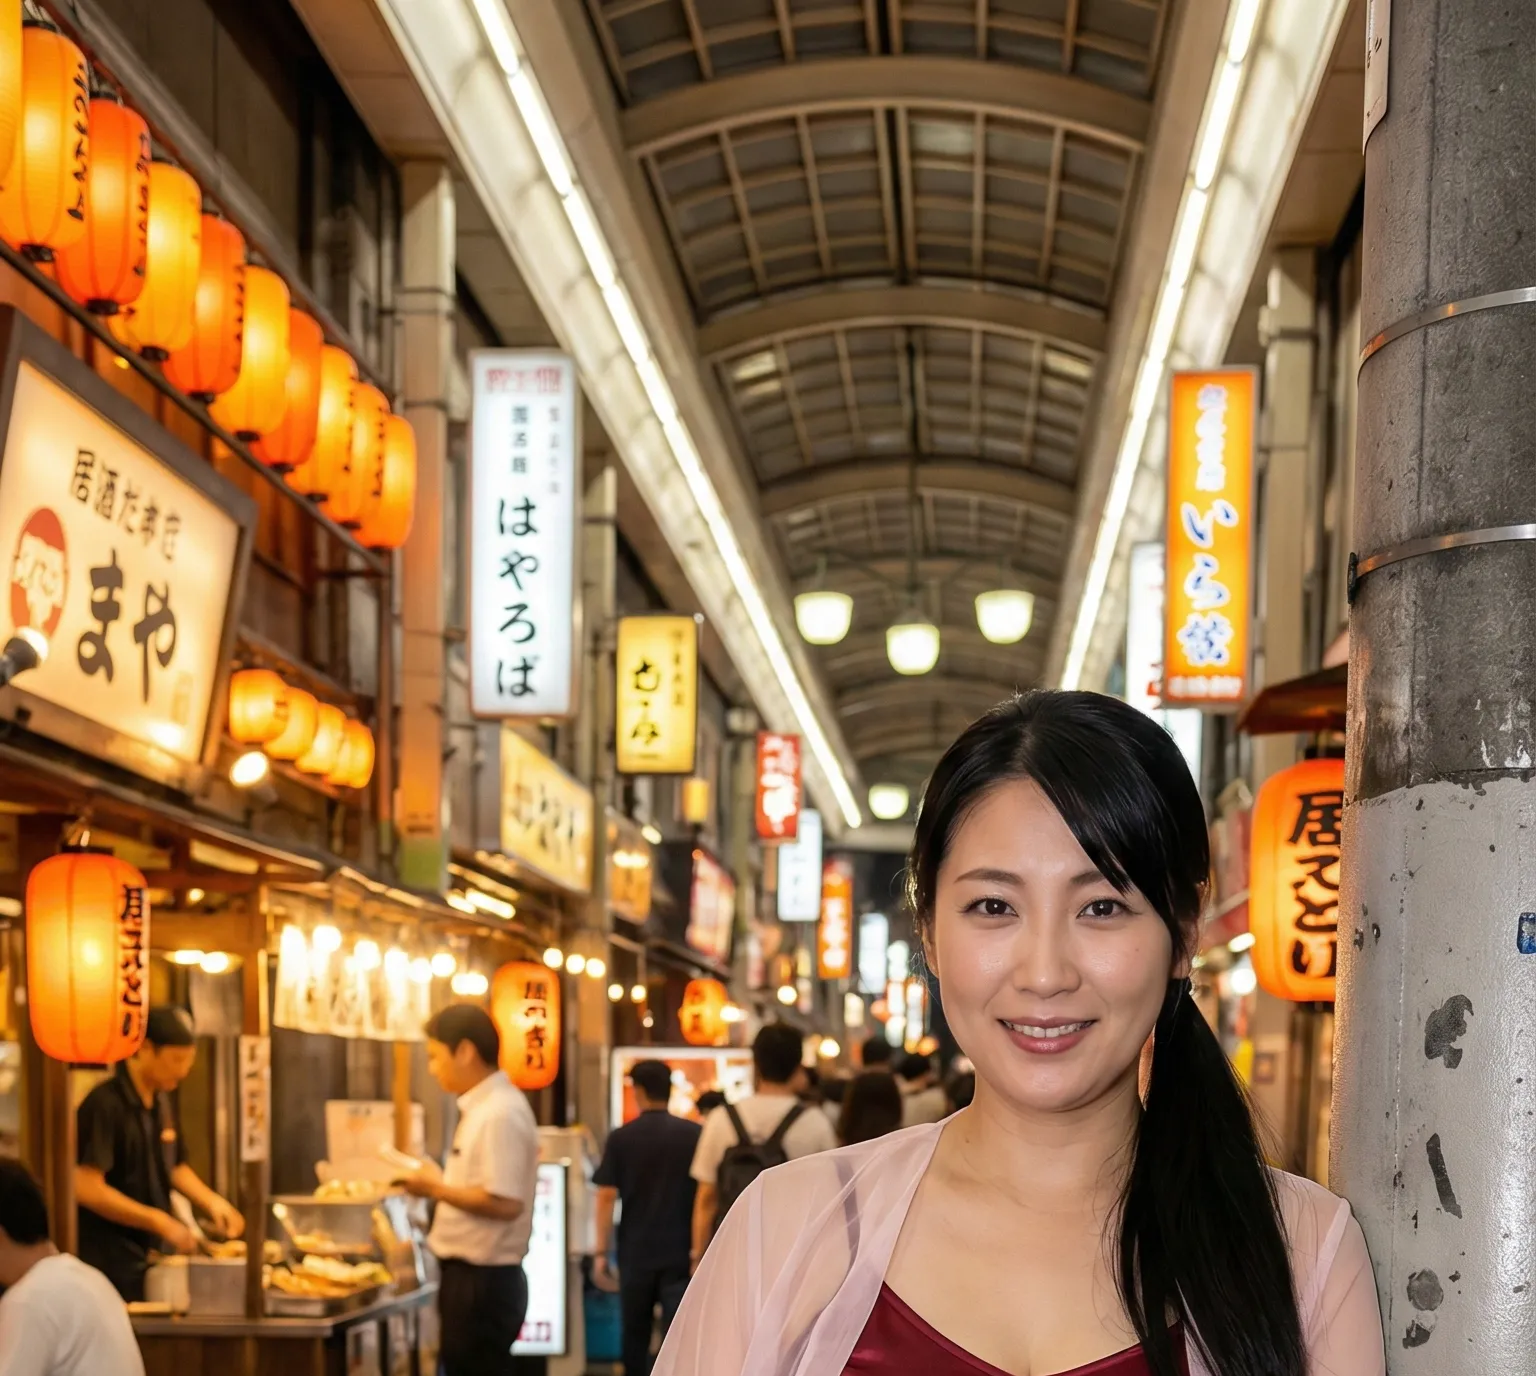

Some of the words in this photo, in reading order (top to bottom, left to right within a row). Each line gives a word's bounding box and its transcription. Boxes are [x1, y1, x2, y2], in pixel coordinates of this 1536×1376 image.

[78, 549, 176, 703] まや
[497, 496, 539, 697] はやろば
